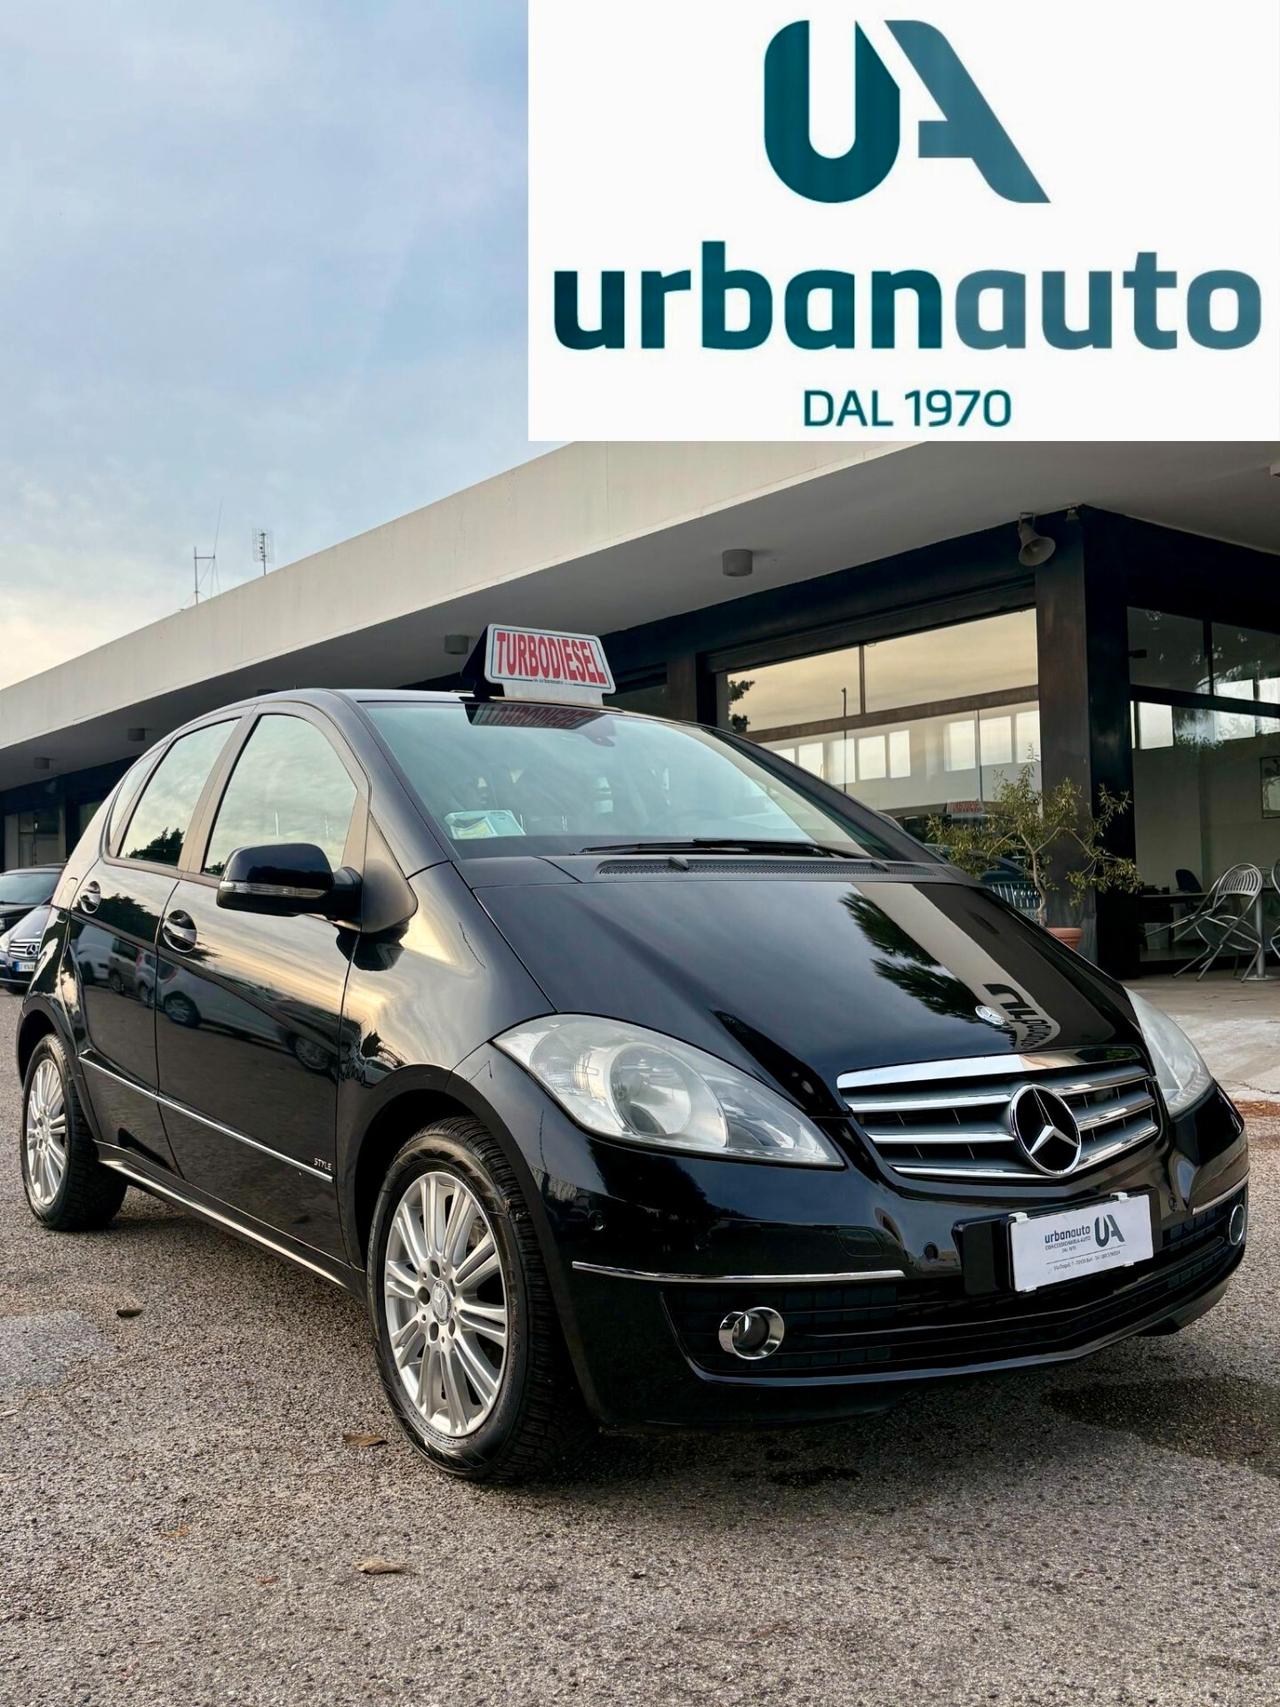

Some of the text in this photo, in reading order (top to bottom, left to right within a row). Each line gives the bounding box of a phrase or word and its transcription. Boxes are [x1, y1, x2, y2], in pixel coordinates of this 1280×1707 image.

[496, 631, 607, 684] TURBODIESEL
[313, 1157, 333, 1171] STYLE
[1044, 1225, 1091, 1243] urbanauto
[1094, 1214, 1125, 1247] UA
